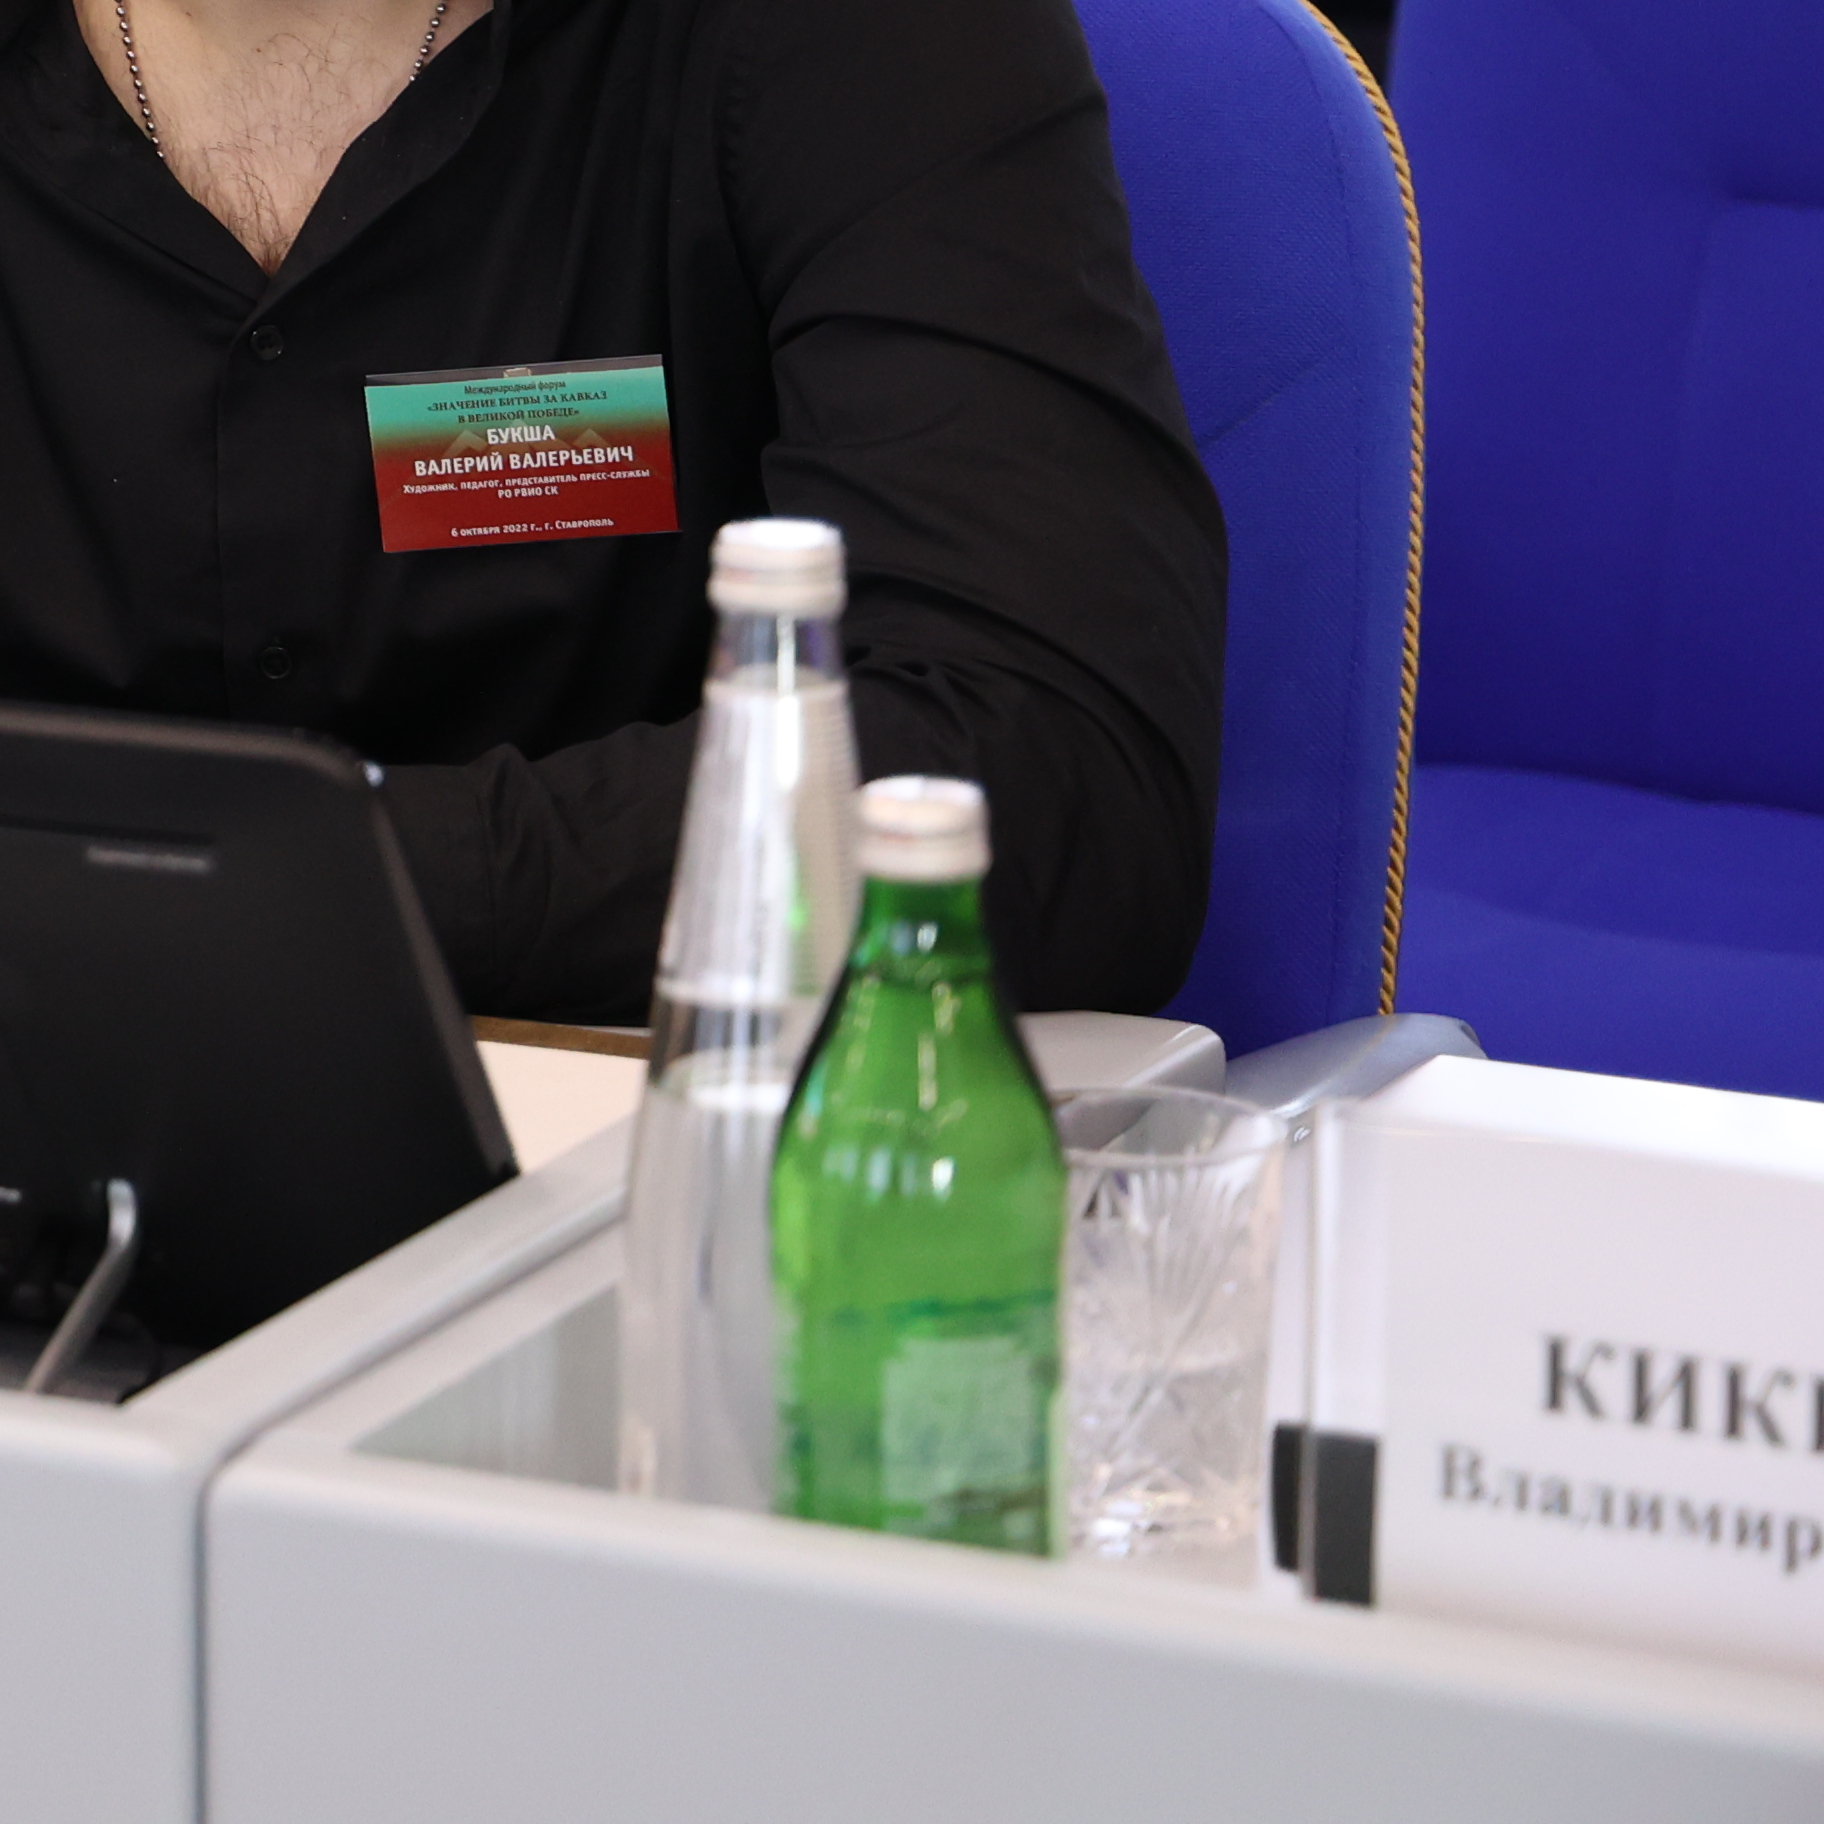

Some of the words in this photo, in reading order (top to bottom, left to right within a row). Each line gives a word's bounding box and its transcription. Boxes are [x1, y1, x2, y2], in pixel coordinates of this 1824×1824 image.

[538, 380, 566, 392] форум
[427, 397, 496, 412] «ЗНАЧЕНИЕ
[499, 395, 540, 407] БИТВЫ
[543, 393, 558, 404] ЗА
[560, 390, 607, 402] КАВКАЗ
[458, 415, 466, 424] В
[468, 409, 525, 423] ВЕЛИКОЙ
[528, 407, 579, 419] ПОБЕДЕ»
[487, 425, 555, 444] БУКША
[414, 451, 503, 477] ВАЛЕРИЙ
[509, 446, 634, 470] ВАЛЕРЬЕВИЧ
[497, 489, 512, 498] РО
[514, 487, 543, 497] РВИО
[545, 486, 559, 496] СК
[451, 528, 458, 537] 6
[503, 523, 528, 533] 2022
